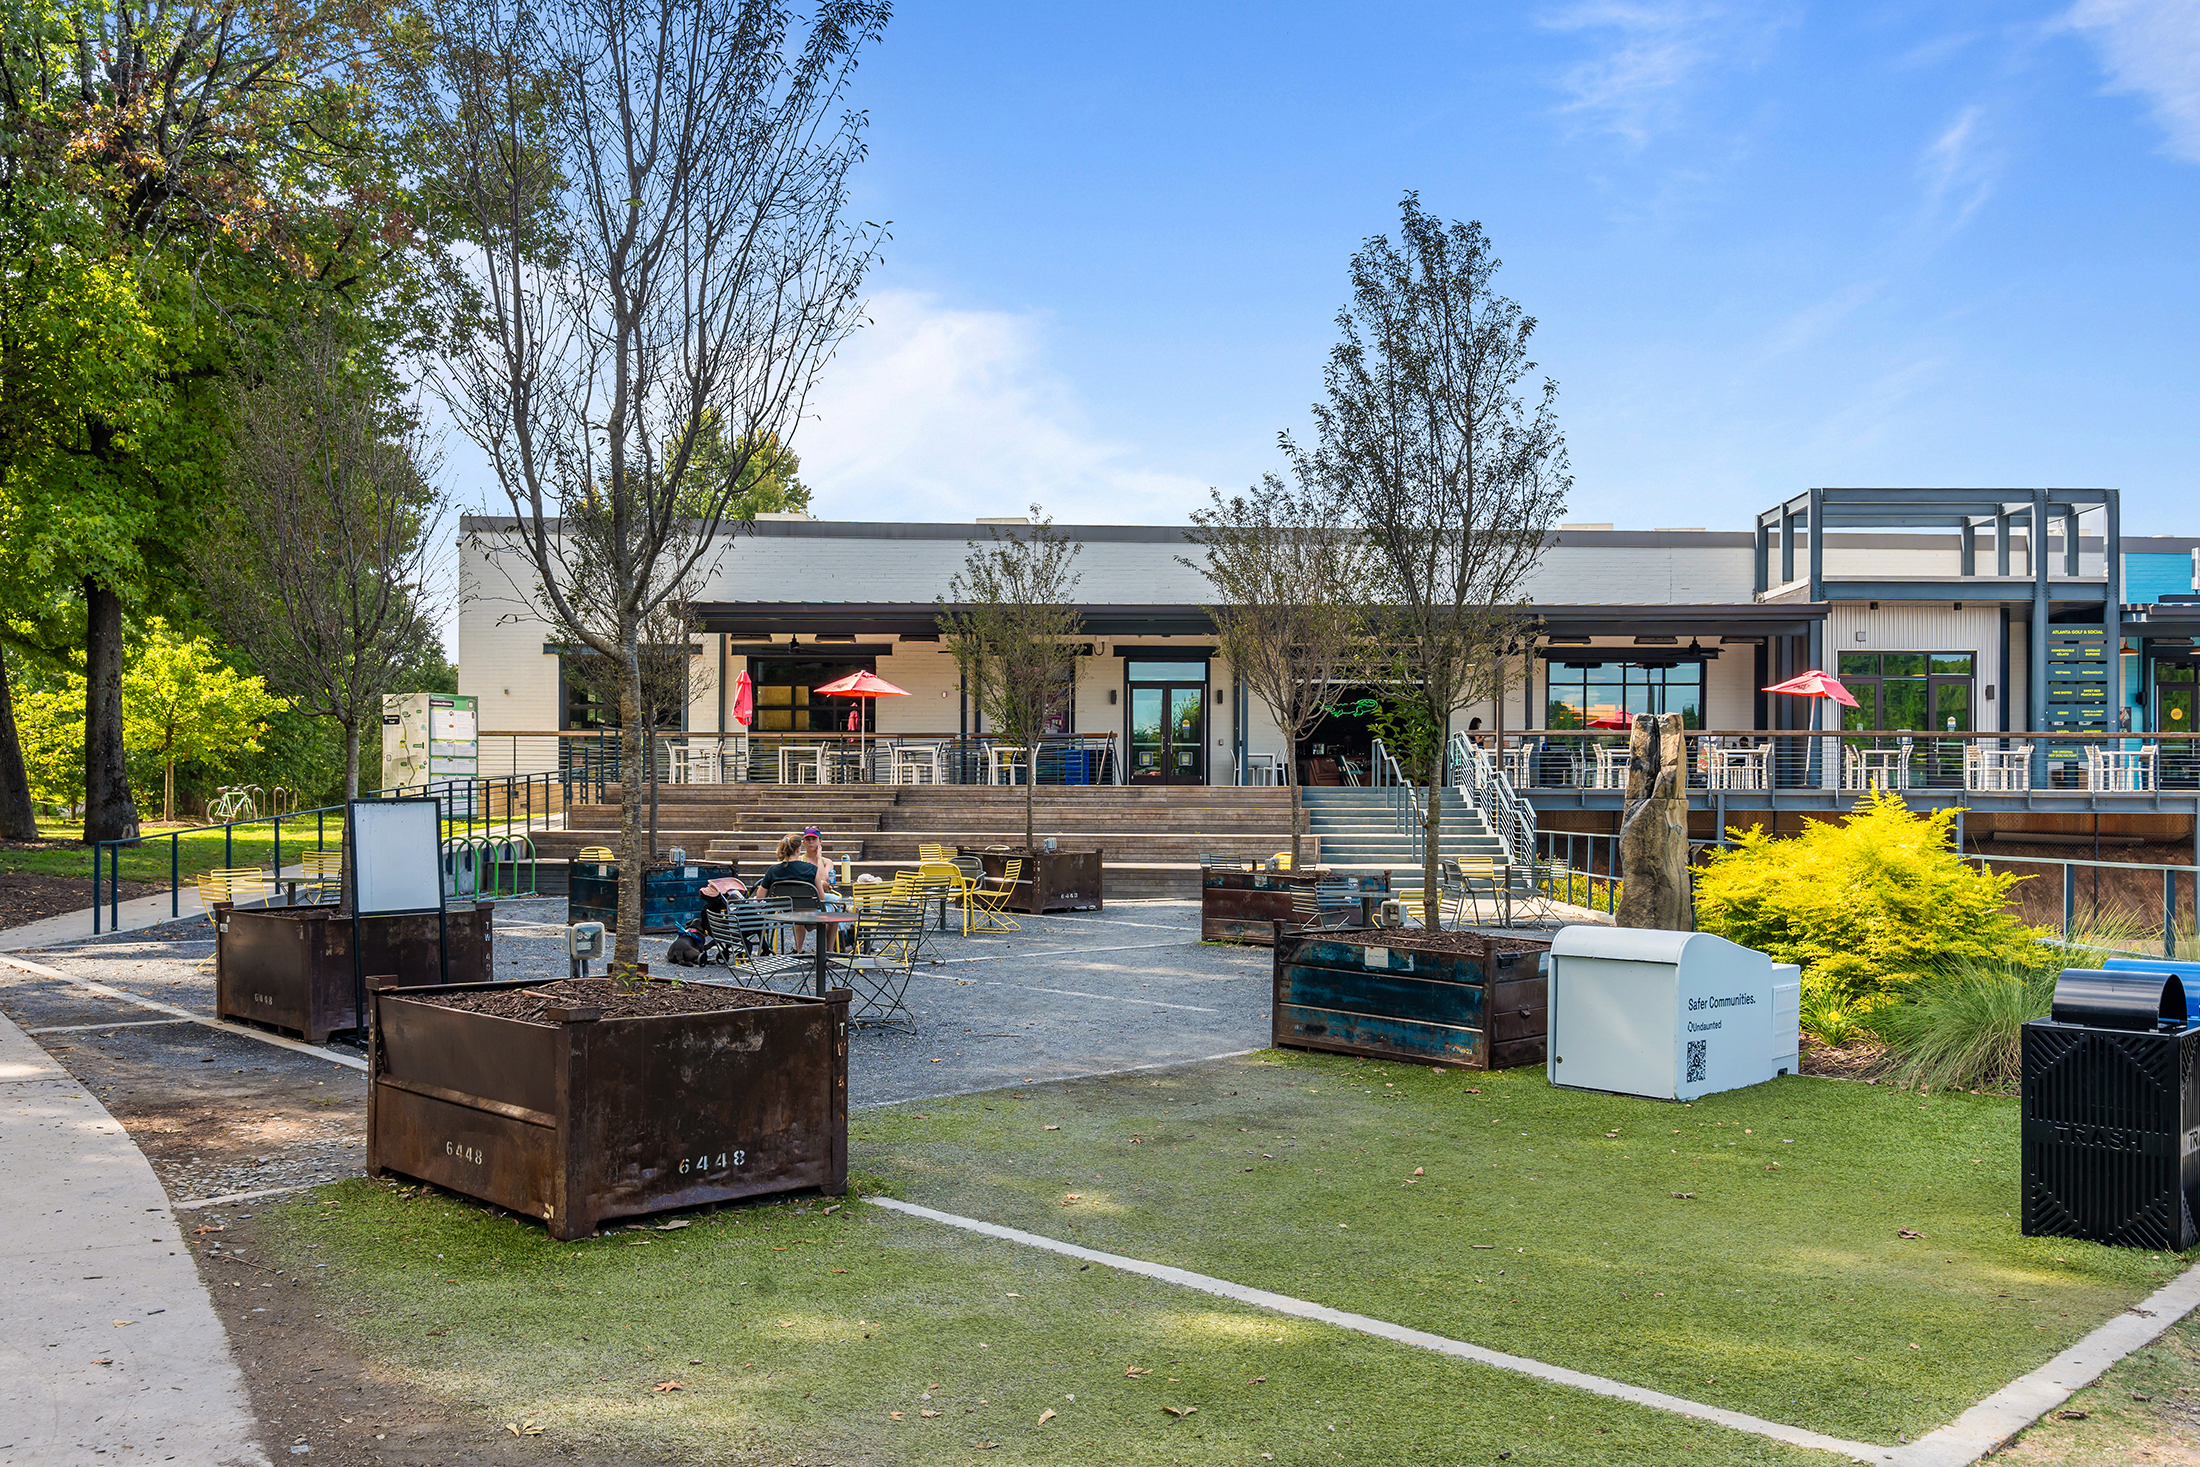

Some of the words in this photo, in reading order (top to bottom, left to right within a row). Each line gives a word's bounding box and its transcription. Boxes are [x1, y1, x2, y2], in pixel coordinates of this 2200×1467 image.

[1688, 998, 1708, 1011] Safer
[1709, 993, 1756, 1009] Communities.
[1692, 1020, 1722, 1032] Undaunted
[2054, 1125, 2142, 1153] TRASH
[446, 1140, 483, 1166] 6448
[678, 1149, 746, 1174] 6448
